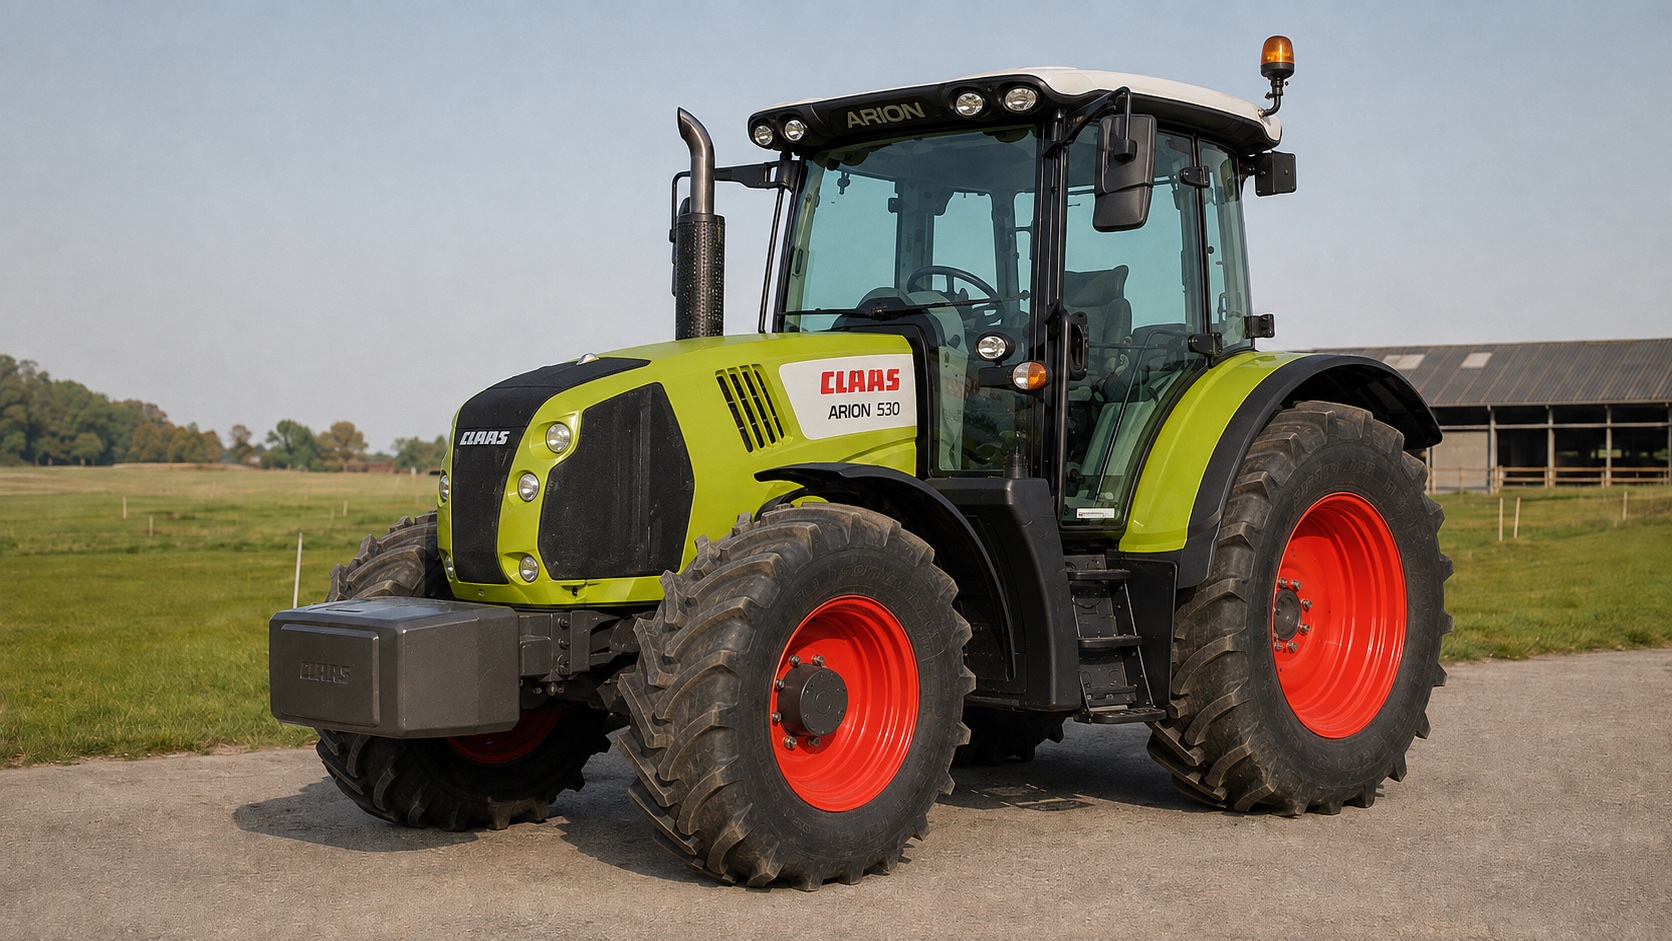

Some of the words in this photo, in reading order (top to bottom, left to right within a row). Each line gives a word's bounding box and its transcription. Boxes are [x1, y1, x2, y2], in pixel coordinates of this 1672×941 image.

[847, 102, 926, 128] ARION
[820, 368, 900, 394] CLAAS
[828, 403, 871, 420] ARION
[876, 401, 900, 417] 530
[459, 431, 510, 446] CLAAS
